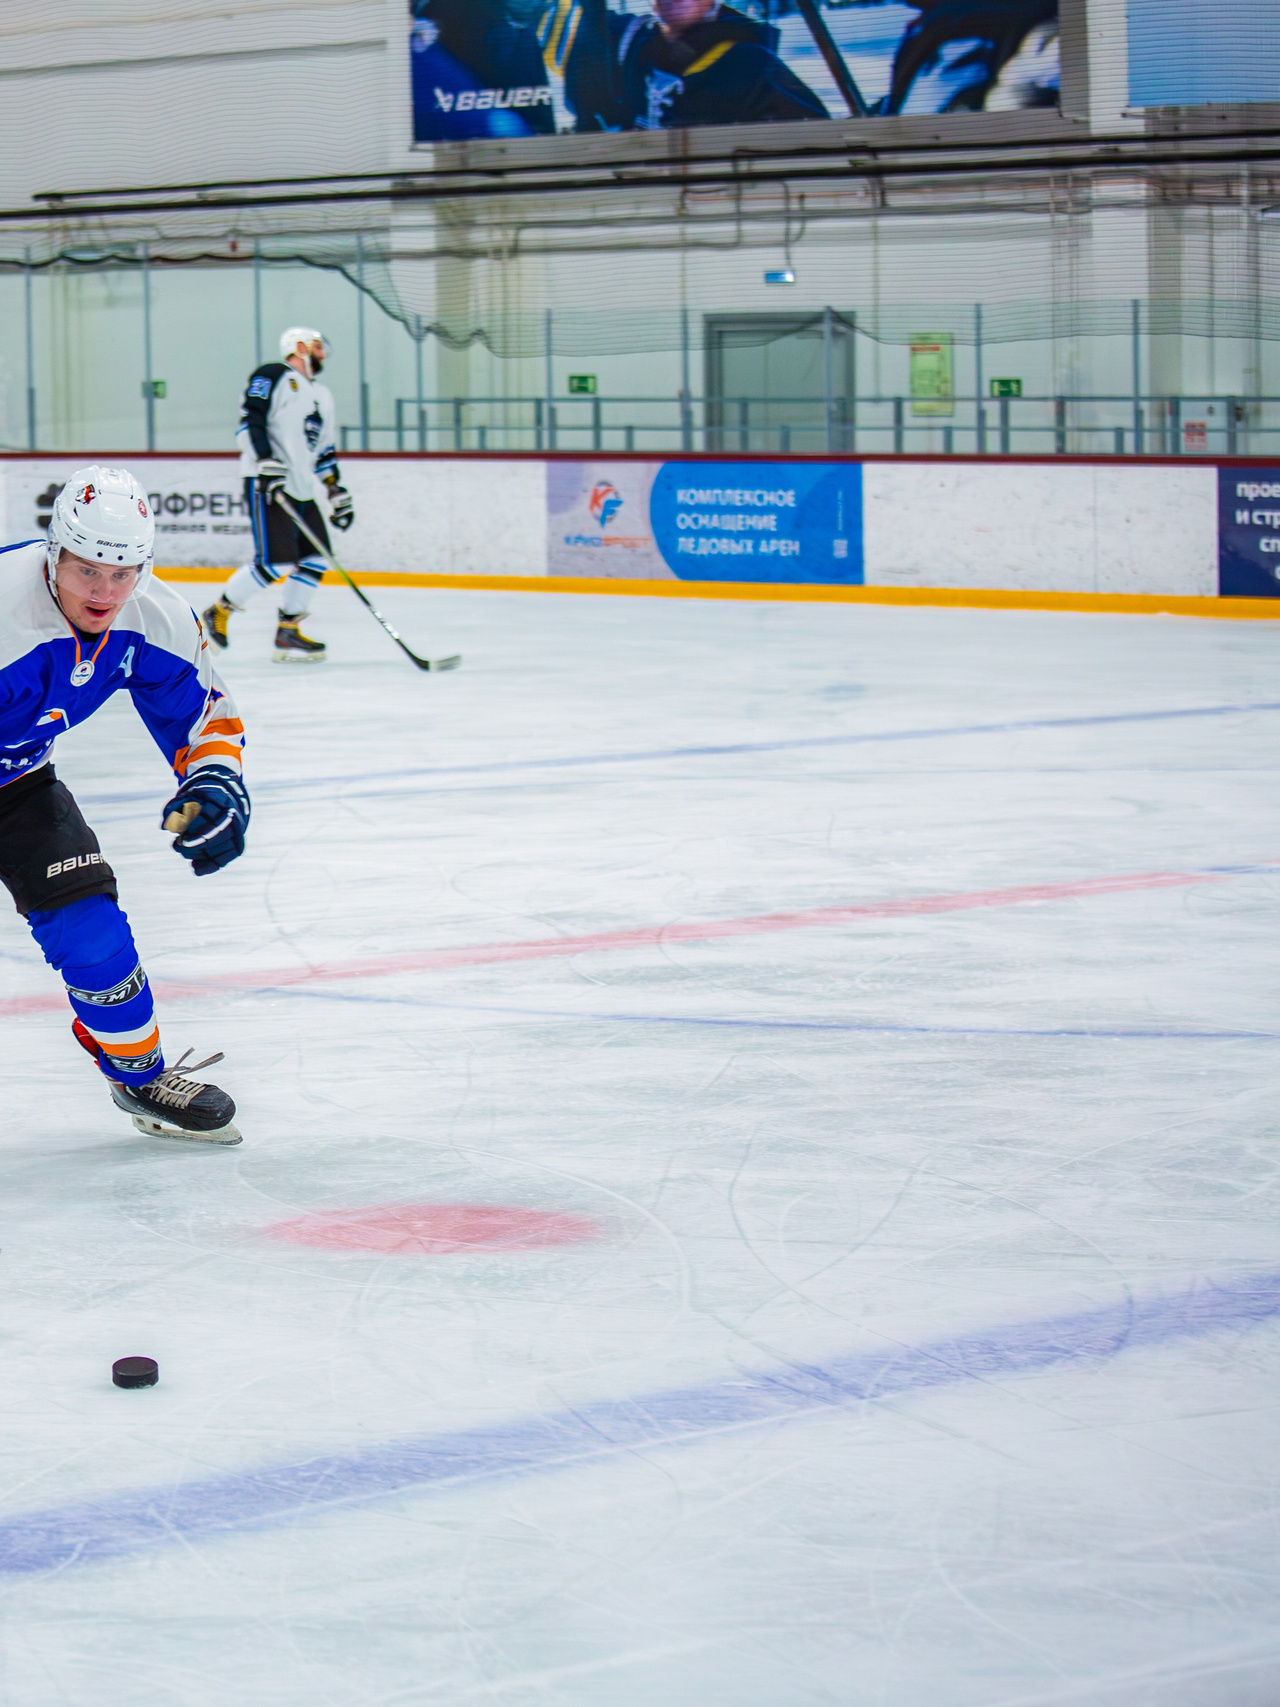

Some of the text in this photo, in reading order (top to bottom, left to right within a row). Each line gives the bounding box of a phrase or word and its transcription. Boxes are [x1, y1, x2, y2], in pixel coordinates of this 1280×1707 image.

[455, 86, 551, 111] BAUER
[677, 489, 796, 507] КОМПЛЕКСНОЕ
[676, 513, 777, 532] ОСНАЩЕНИЕ
[96, 540, 129, 549] BAUER
[677, 537, 800, 556] ЛЕДОВЫХ АРЕН
[109, 646, 136, 678] A
